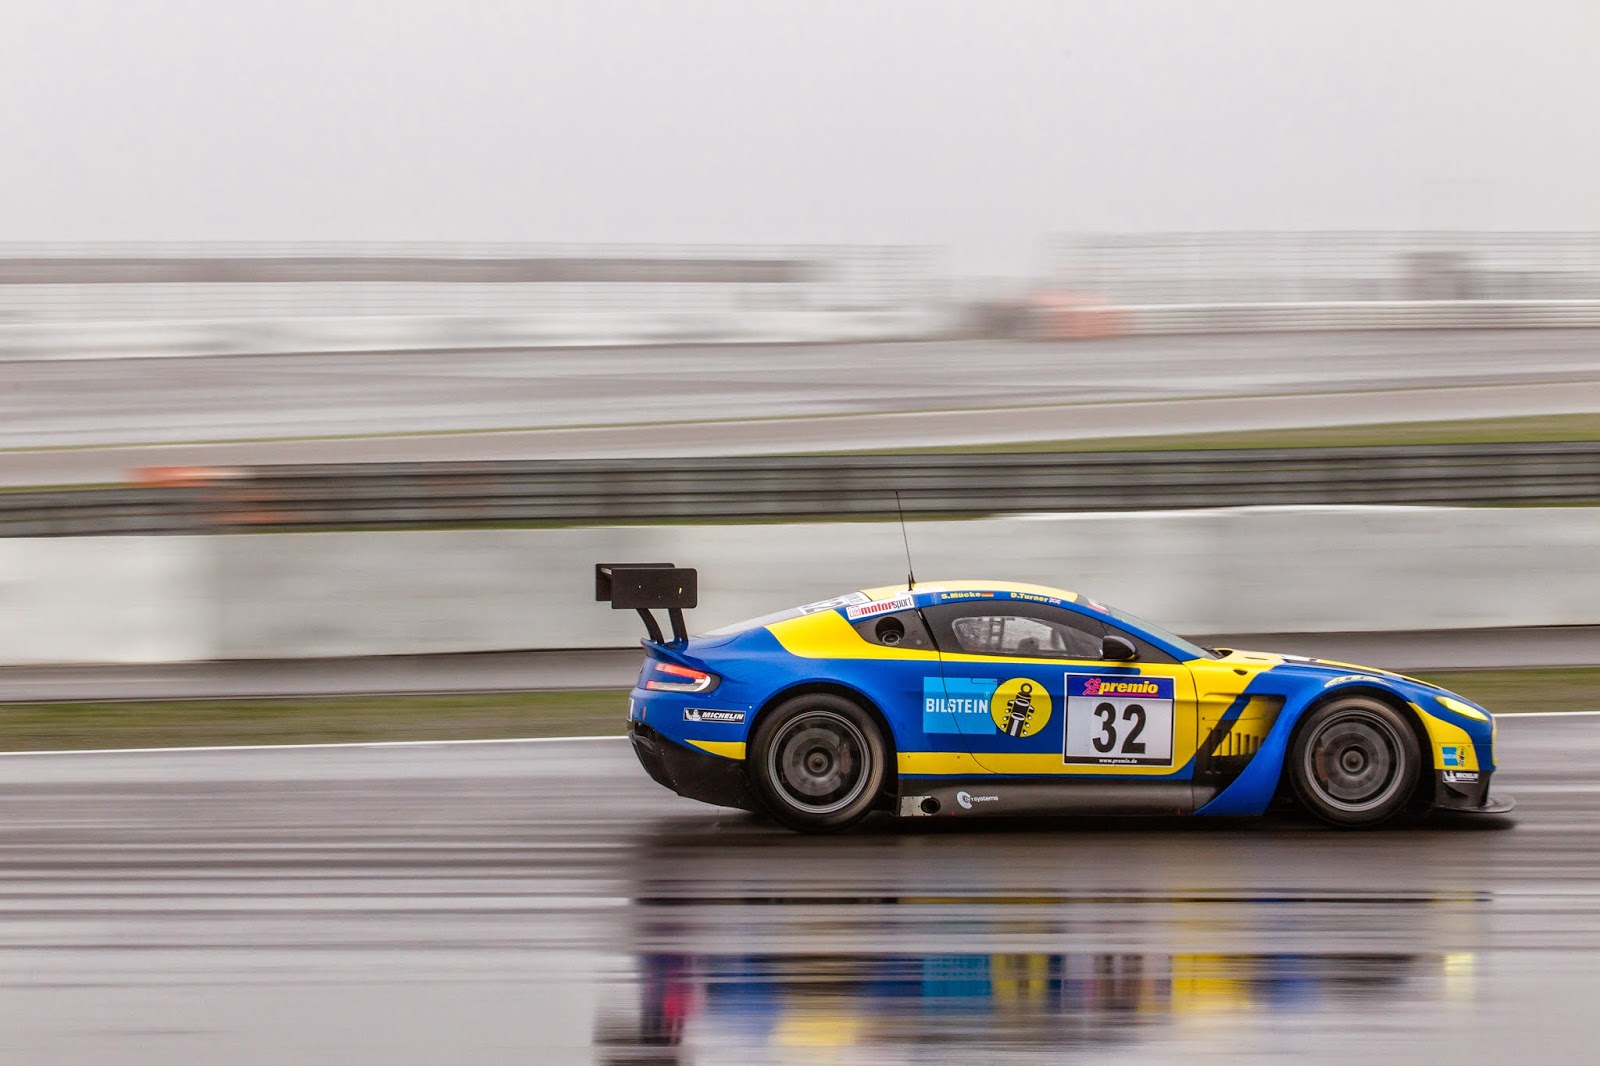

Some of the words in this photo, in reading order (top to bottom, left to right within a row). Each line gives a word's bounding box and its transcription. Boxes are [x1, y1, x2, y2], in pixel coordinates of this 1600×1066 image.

[1010, 592, 1049, 602] D.Turner
[1098, 681, 1158, 695] premio
[925, 698, 988, 713] BILSTEIN
[702, 712, 744, 720] MICHELIN
[1092, 702, 1146, 754] 32
